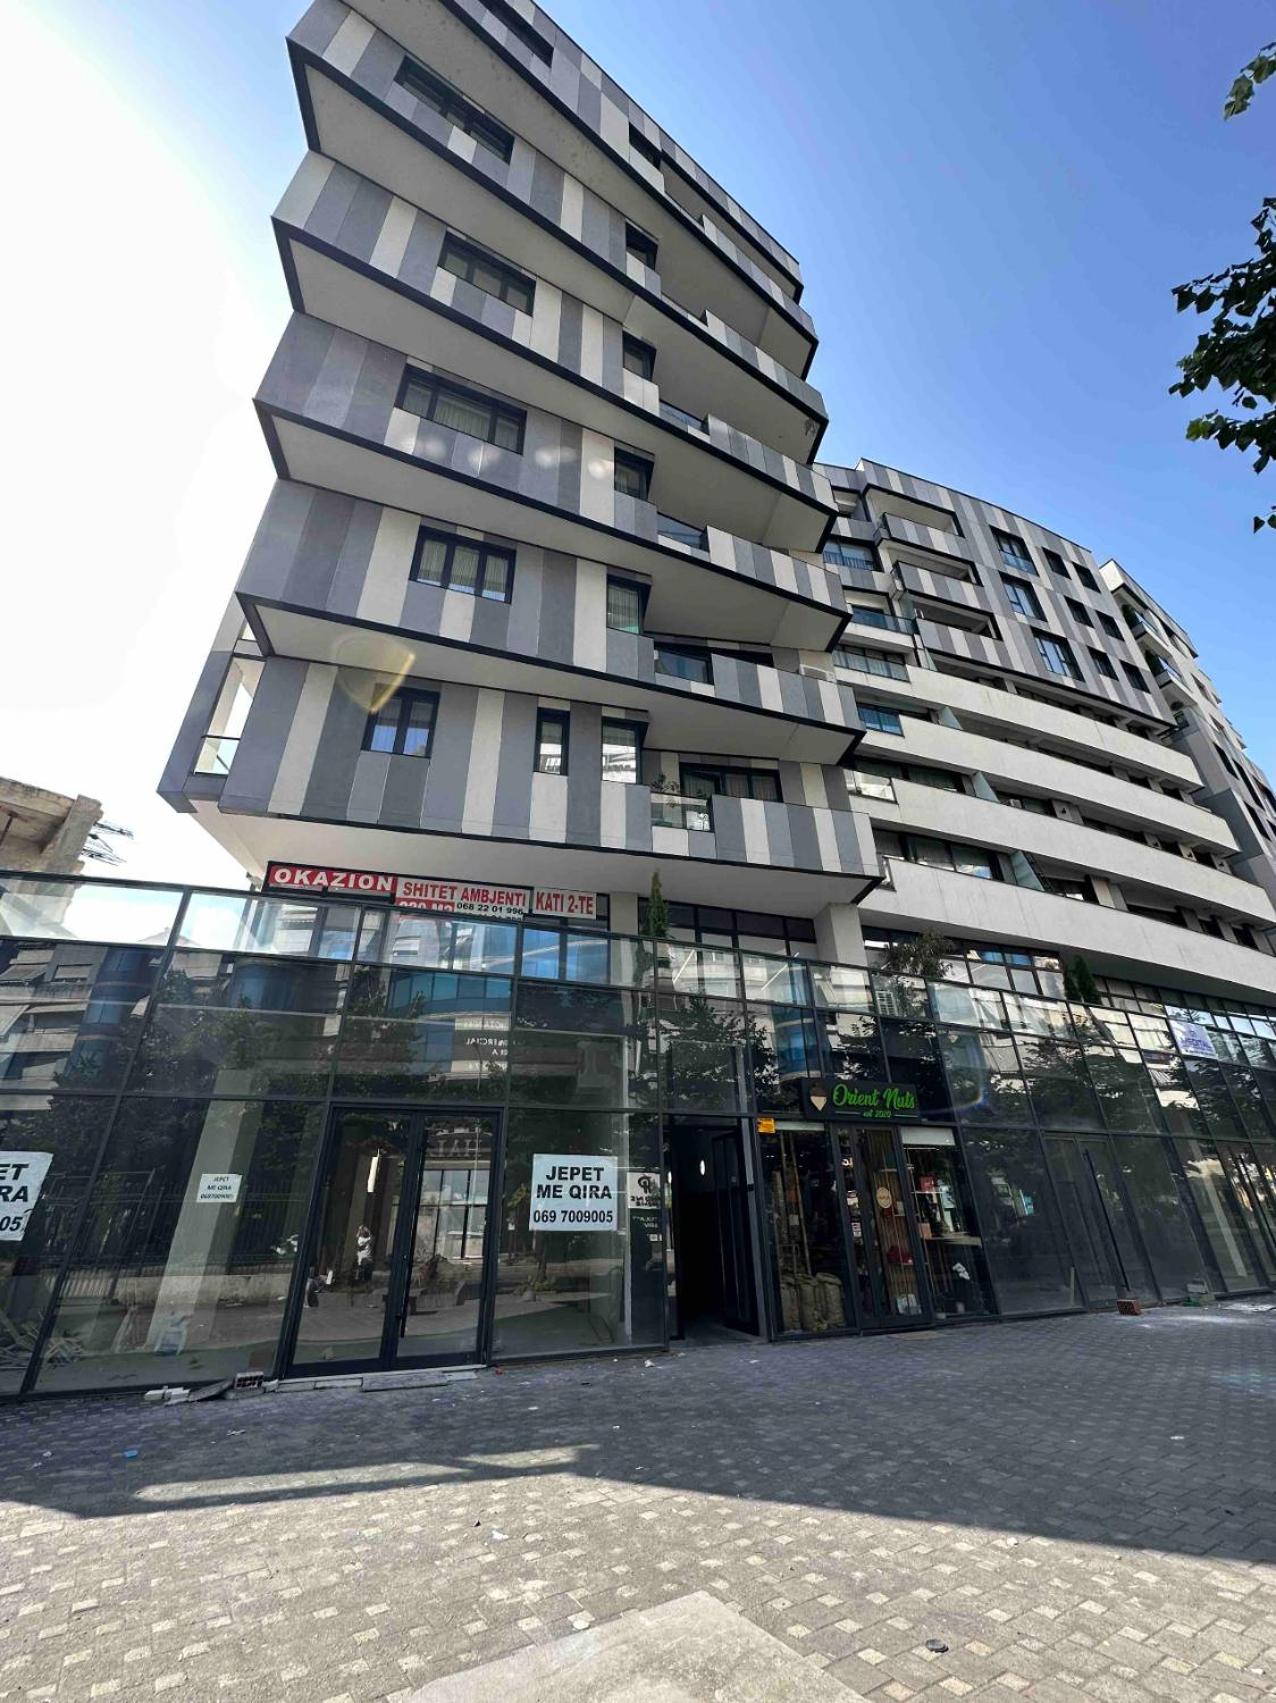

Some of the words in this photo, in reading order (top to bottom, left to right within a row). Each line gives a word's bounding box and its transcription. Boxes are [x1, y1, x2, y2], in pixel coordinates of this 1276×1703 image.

[274, 868, 393, 891] OKAZION
[403, 882, 457, 900] SHITET
[461, 887, 525, 907] AMBJENTI
[536, 891, 564, 913] KATI
[568, 896, 594, 915] 2-TE
[456, 902, 474, 911] 068
[478, 904, 489, 913] 22
[492, 905, 503, 913] 01
[833, 1083, 880, 1106] Orient
[883, 1087, 915, 1110] Nuts
[546, 1166, 604, 1181] JEPET
[537, 1184, 563, 1198] ME
[569, 1185, 612, 1199] QIRA
[533, 1210, 557, 1223] 069
[561, 1210, 613, 1223] 7009005
